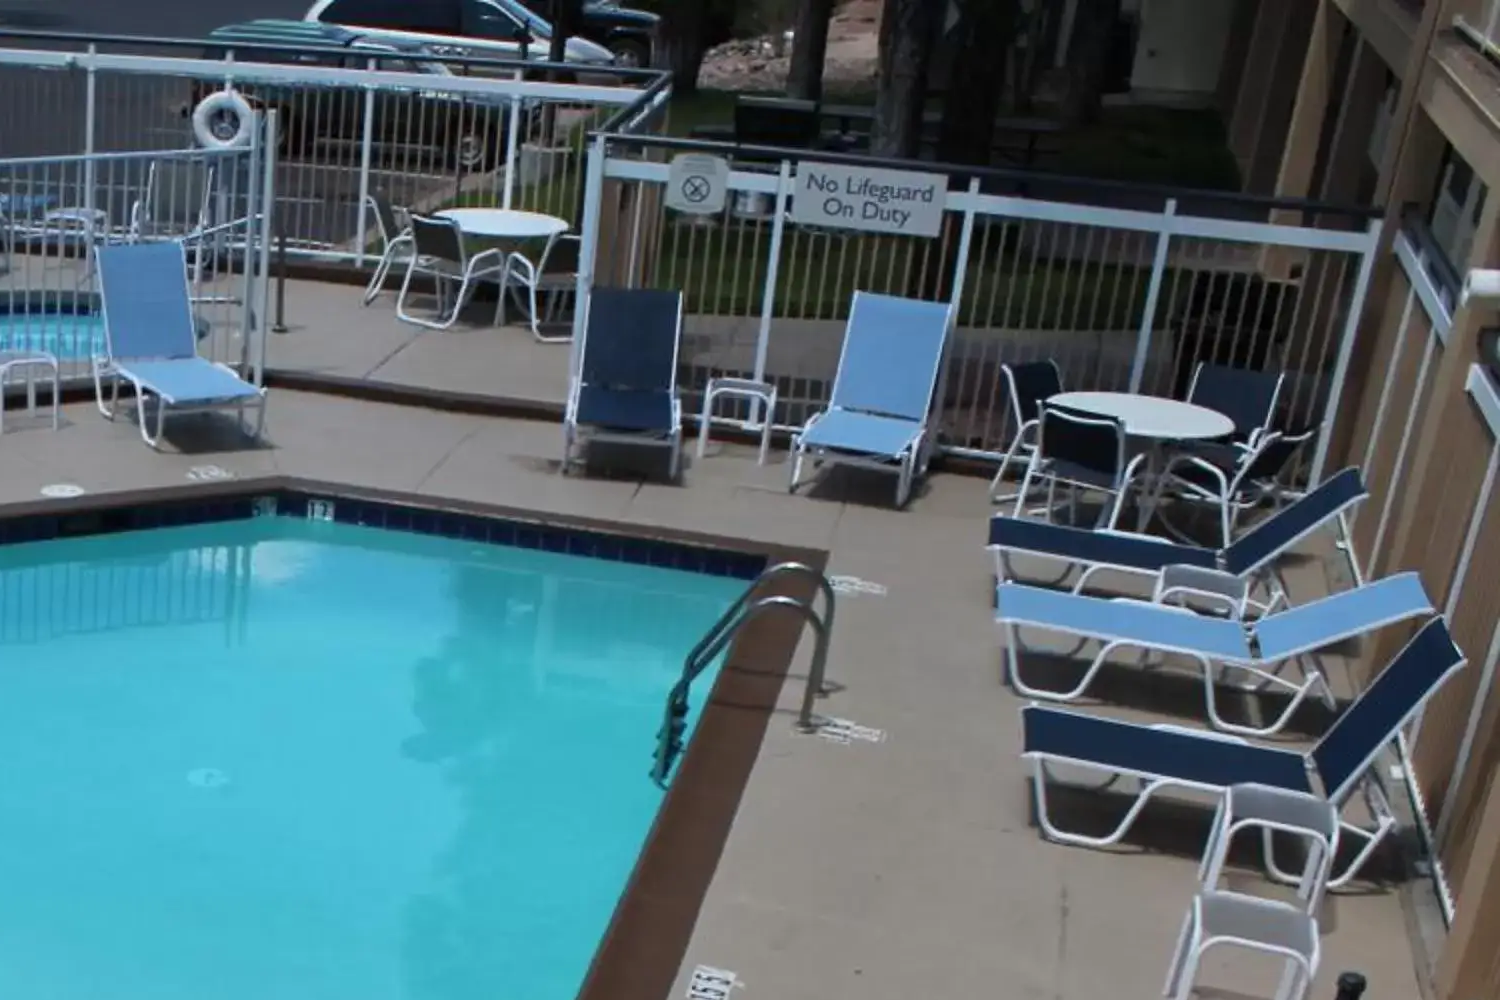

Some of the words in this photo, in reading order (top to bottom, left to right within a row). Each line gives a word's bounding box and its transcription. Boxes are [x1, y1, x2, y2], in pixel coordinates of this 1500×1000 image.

[806, 172, 839, 193] No
[846, 175, 935, 203] Lifeguard
[823, 197, 854, 217] On
[862, 200, 911, 228] Duty
